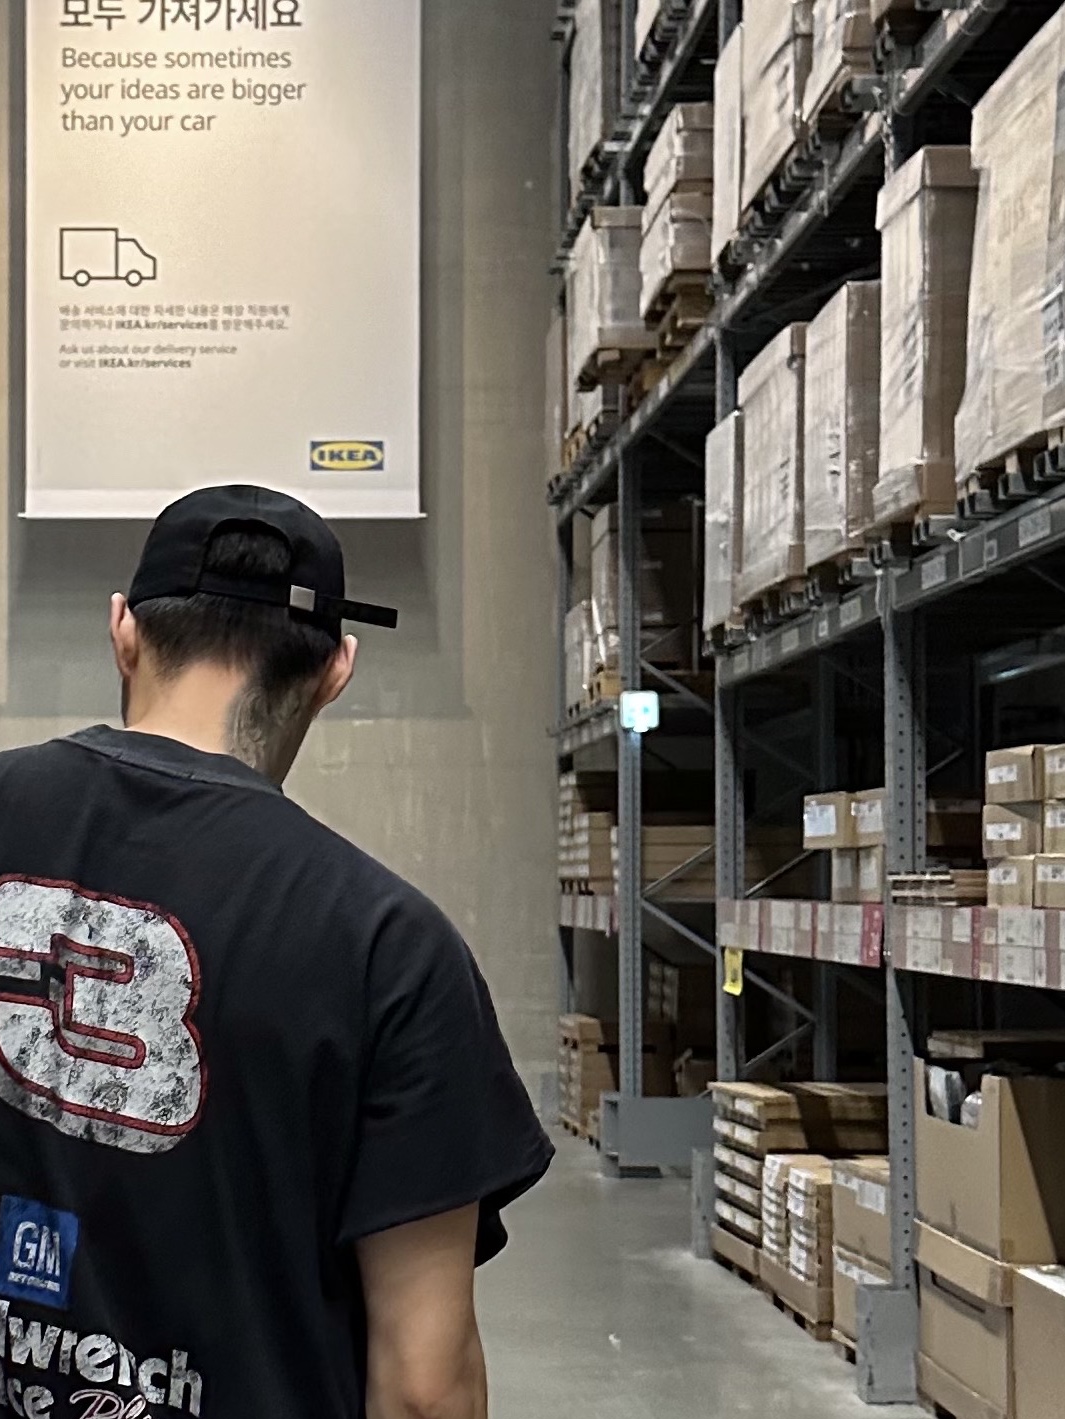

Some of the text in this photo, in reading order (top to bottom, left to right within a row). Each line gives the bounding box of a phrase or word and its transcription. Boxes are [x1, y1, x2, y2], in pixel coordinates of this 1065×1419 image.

[60, 0, 303, 31] 모두 가져가세요
[62, 47, 292, 69] Because sometimes
[60, 78, 307, 106] your ideas are bigger
[62, 110, 216, 138] than your car
[98, 344, 129, 354] about
[153, 344, 197, 356] delivery
[316, 449, 379, 464] IKEA
[12, 1221, 61, 1277] GM
